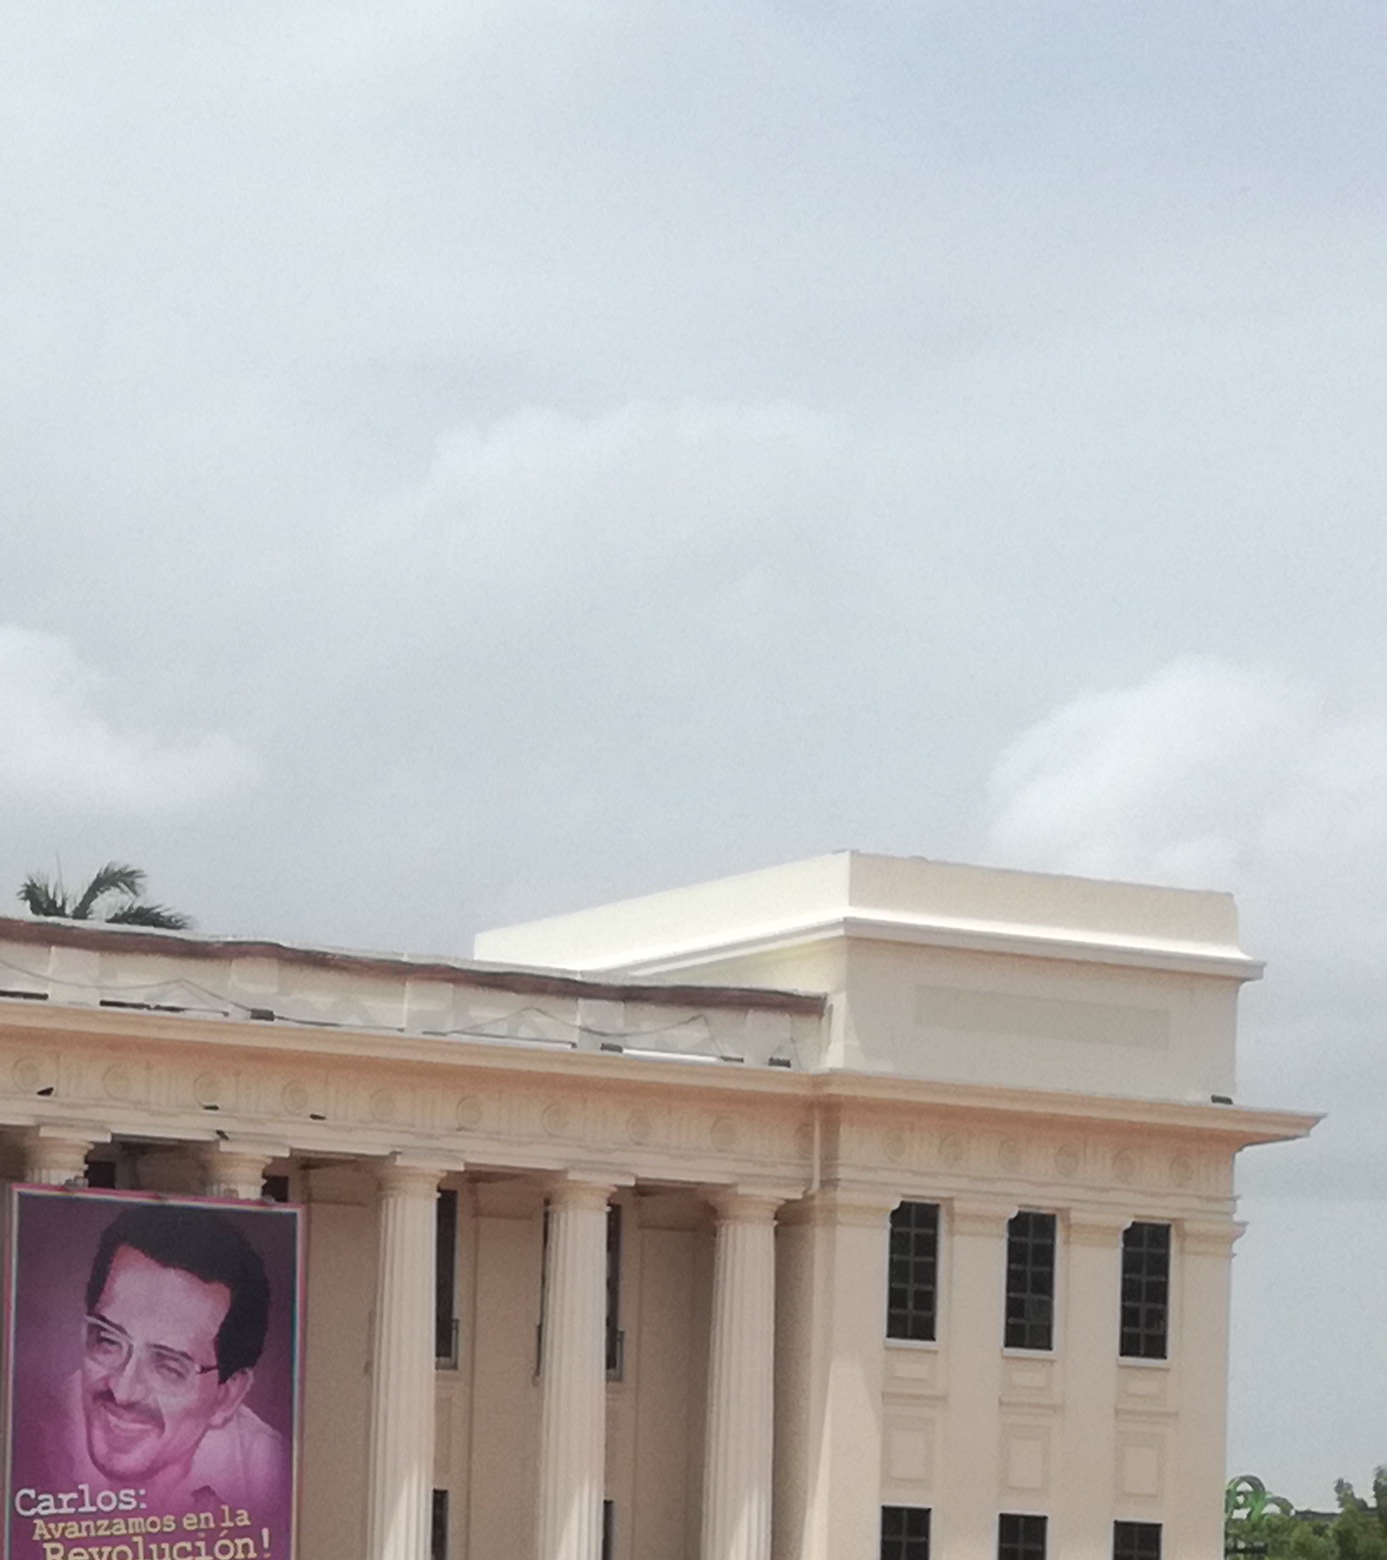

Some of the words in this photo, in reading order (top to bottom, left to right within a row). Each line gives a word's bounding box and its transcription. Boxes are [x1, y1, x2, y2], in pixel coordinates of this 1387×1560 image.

[15, 1484, 147, 1517] Carlos:
[32, 1515, 177, 1542] Avanzamos
[182, 1512, 216, 1531] en
[220, 1505, 252, 1528] la
